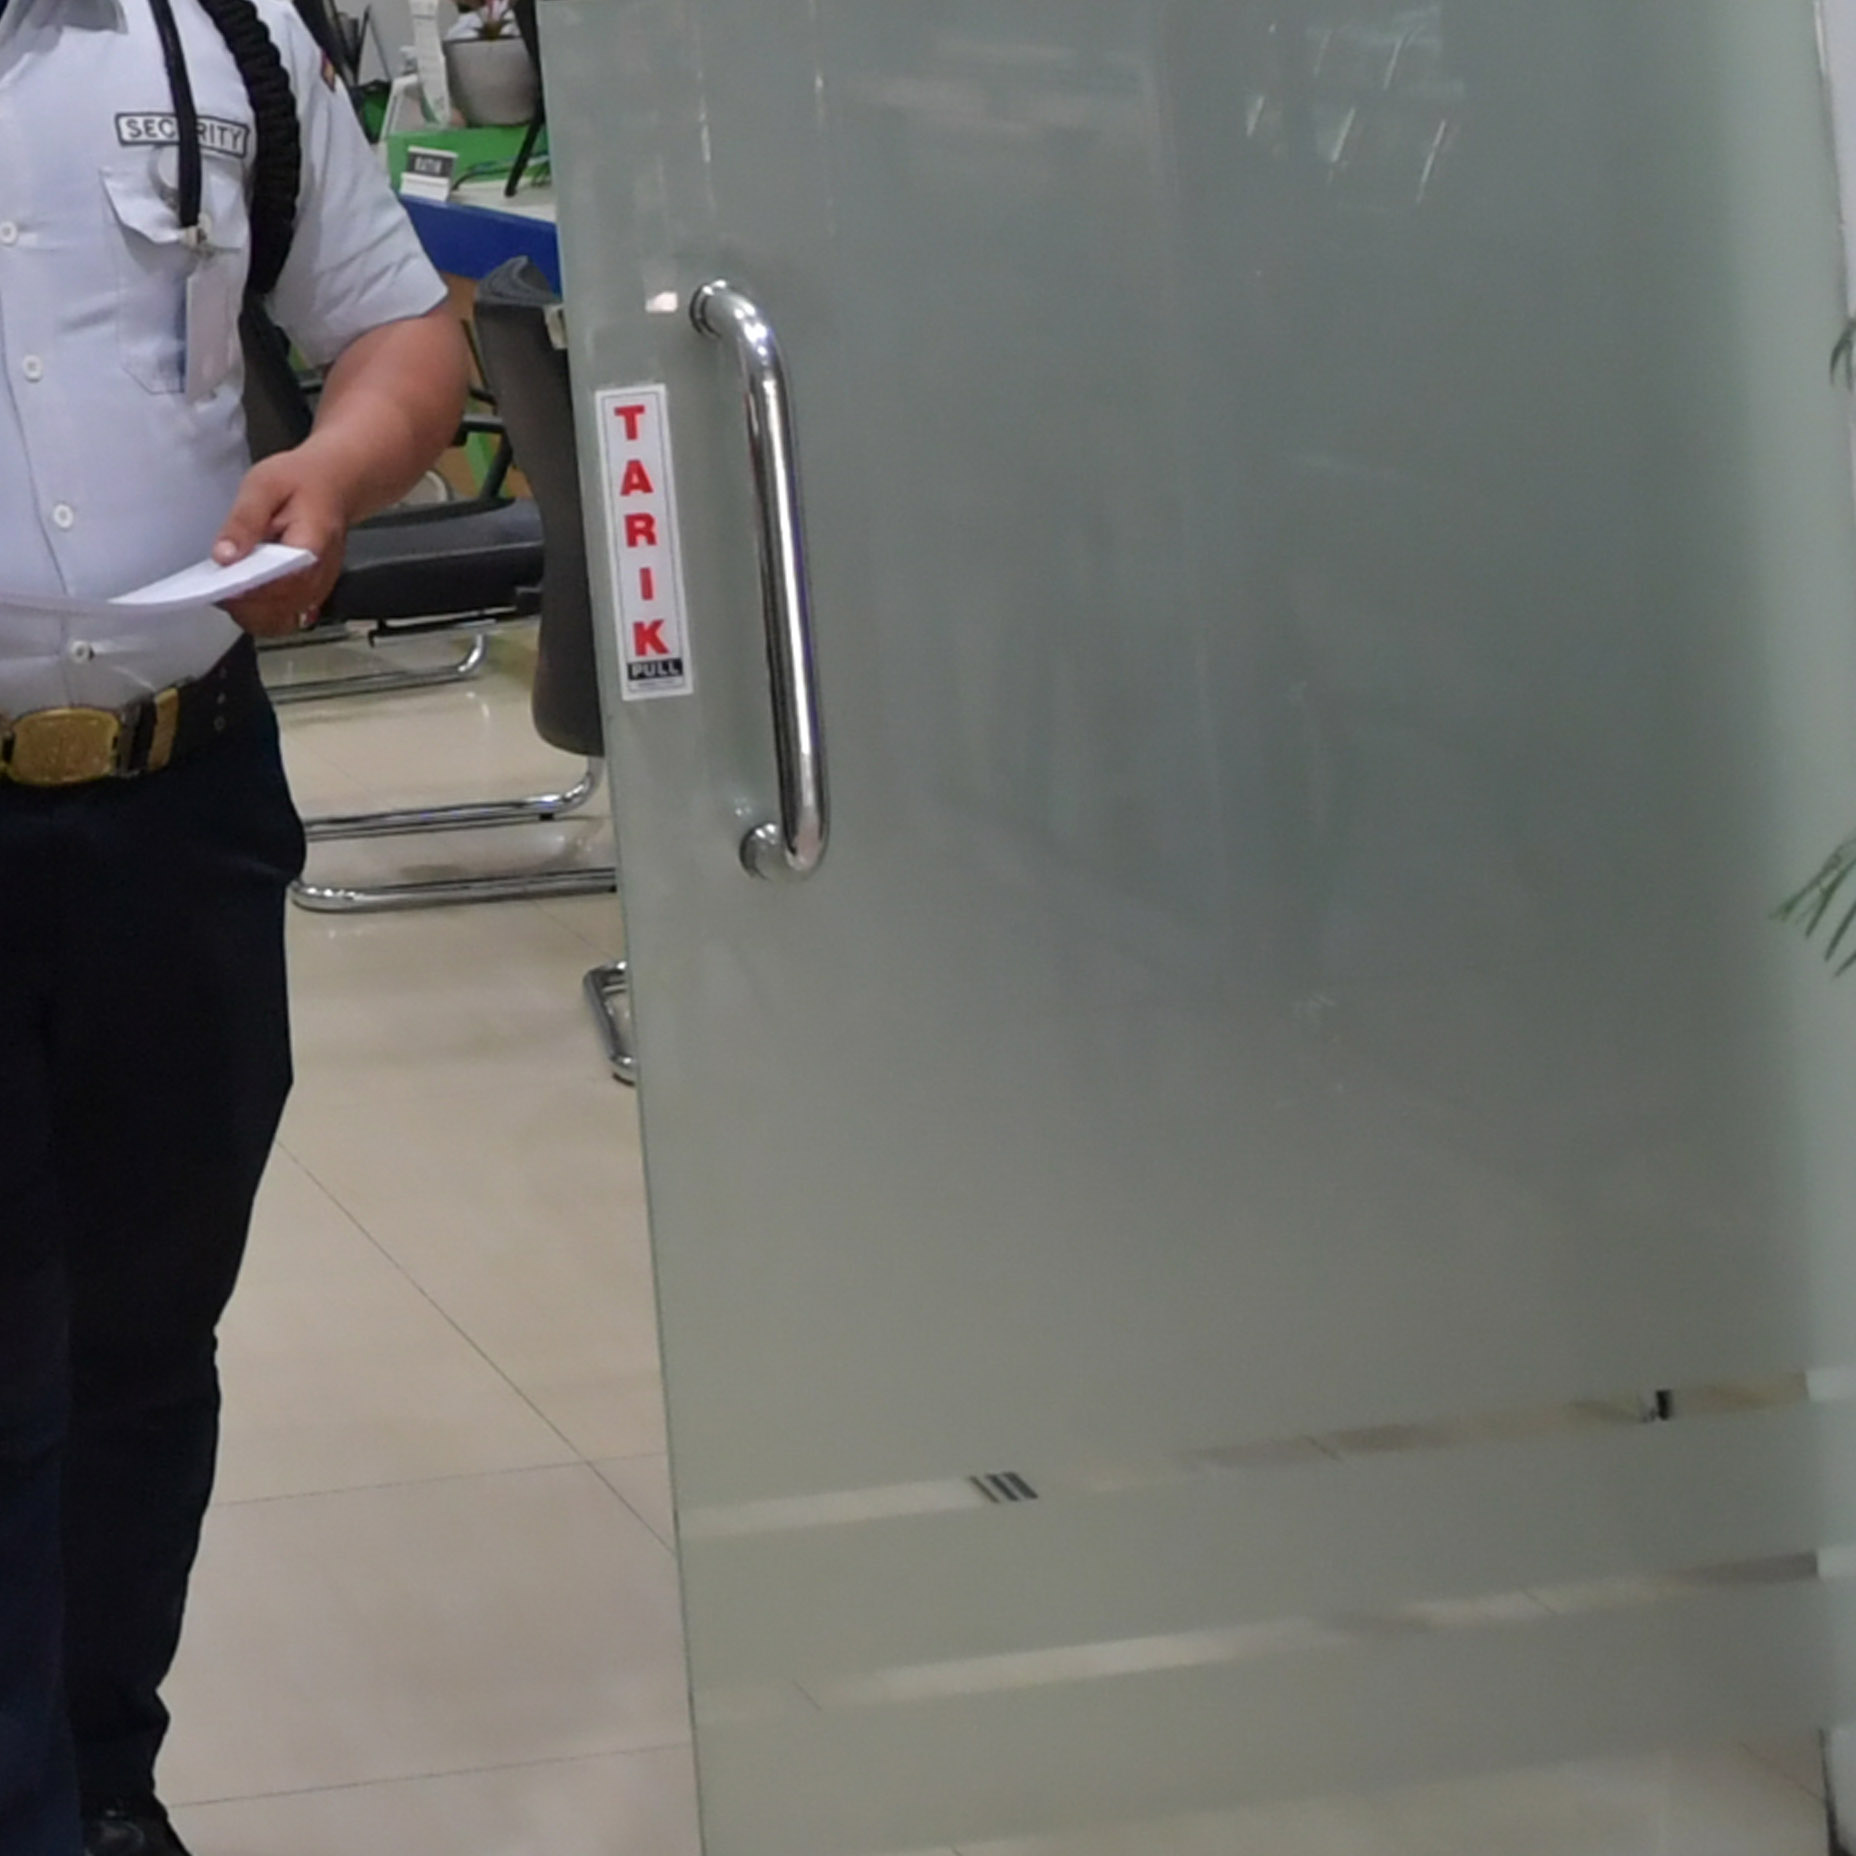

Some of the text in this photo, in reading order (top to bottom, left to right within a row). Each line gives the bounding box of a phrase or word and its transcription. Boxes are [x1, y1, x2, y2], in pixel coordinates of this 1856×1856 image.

[125, 118, 243, 150] SECRITY
[614, 404, 670, 657] TARIK
[631, 659, 680, 678] PULL
